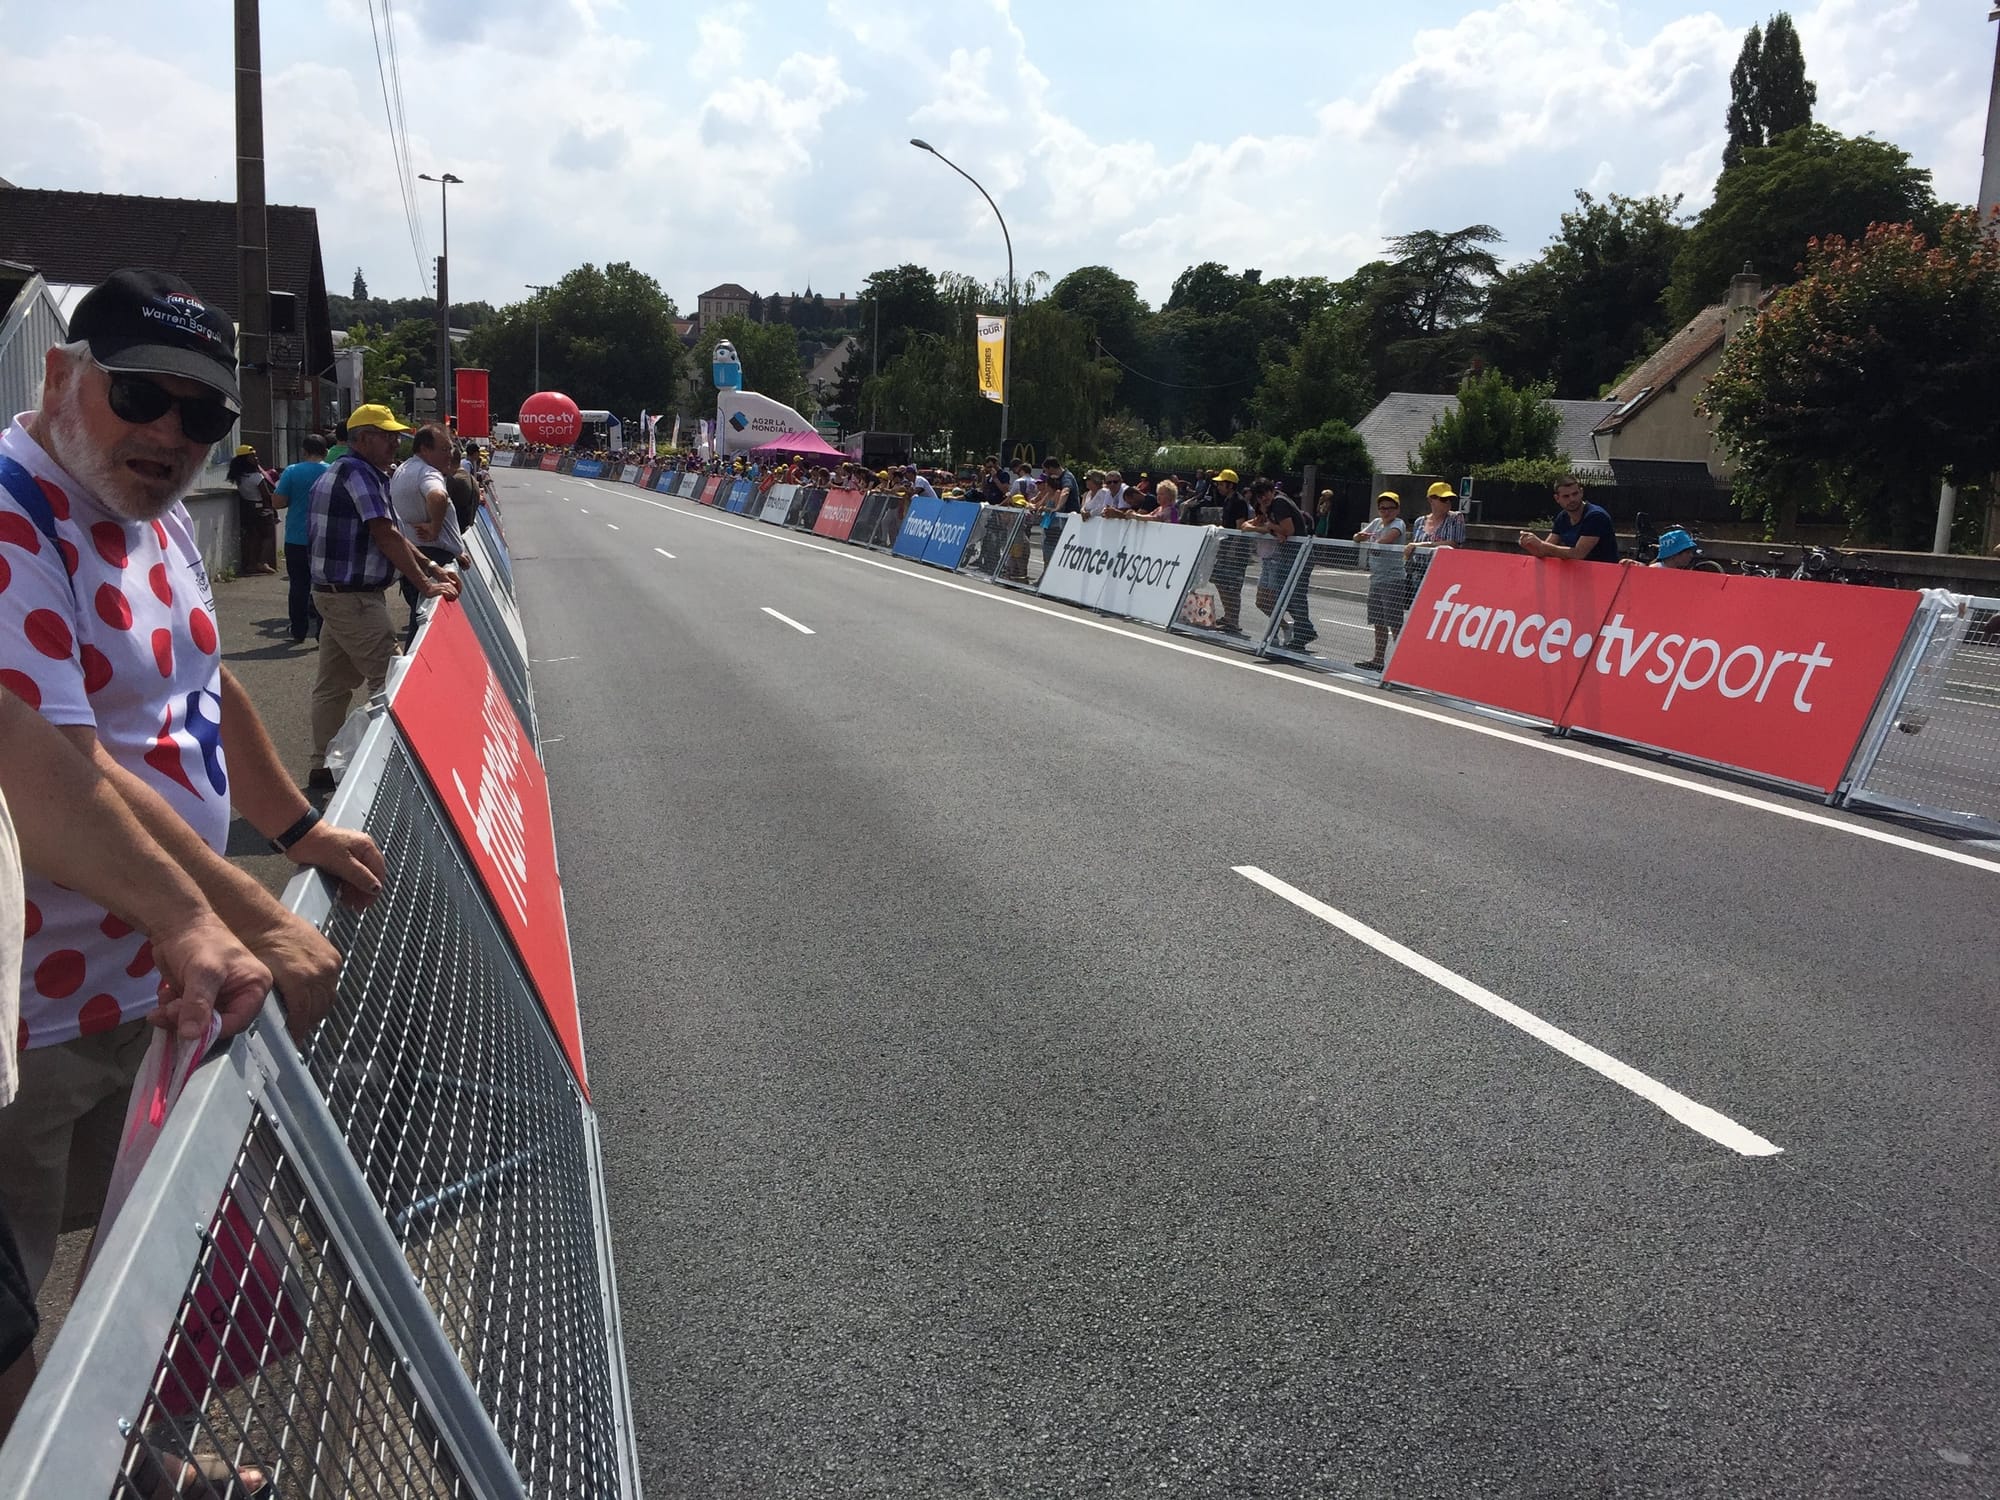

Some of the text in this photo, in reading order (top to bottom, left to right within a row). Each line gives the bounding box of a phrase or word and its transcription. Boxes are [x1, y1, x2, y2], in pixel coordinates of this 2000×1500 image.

[142, 306, 222, 344] Warren Barguil
[985, 347, 993, 388] CHARTRES
[752, 417, 774, 426] AG2R
[538, 424, 575, 438] sport
[751, 425, 792, 433] MONDIALE
